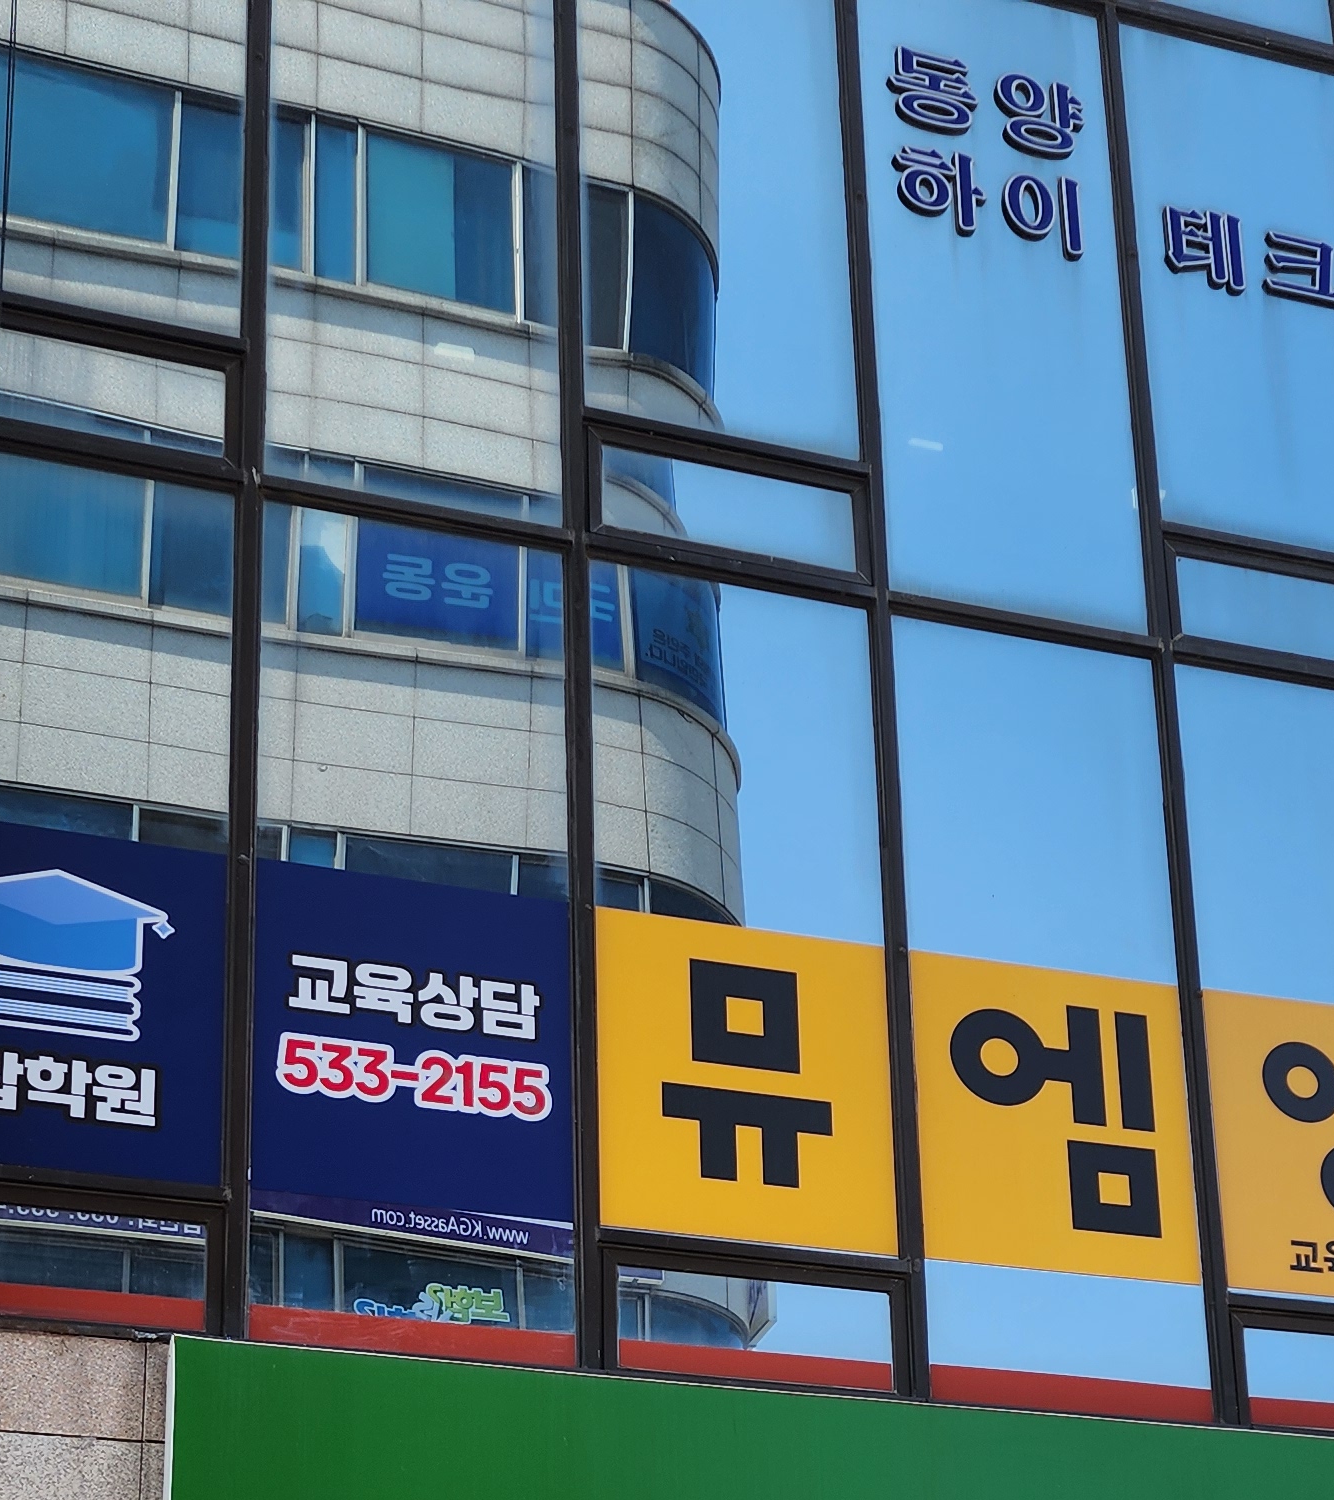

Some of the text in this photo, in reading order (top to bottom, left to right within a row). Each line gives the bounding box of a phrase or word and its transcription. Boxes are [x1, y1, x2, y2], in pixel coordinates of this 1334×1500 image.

[884, 44, 1085, 160] 동양
[890, 143, 1085, 262] 하이
[287, 953, 541, 1041] 교육상담
[276, 1031, 552, 1122] 533-2155
